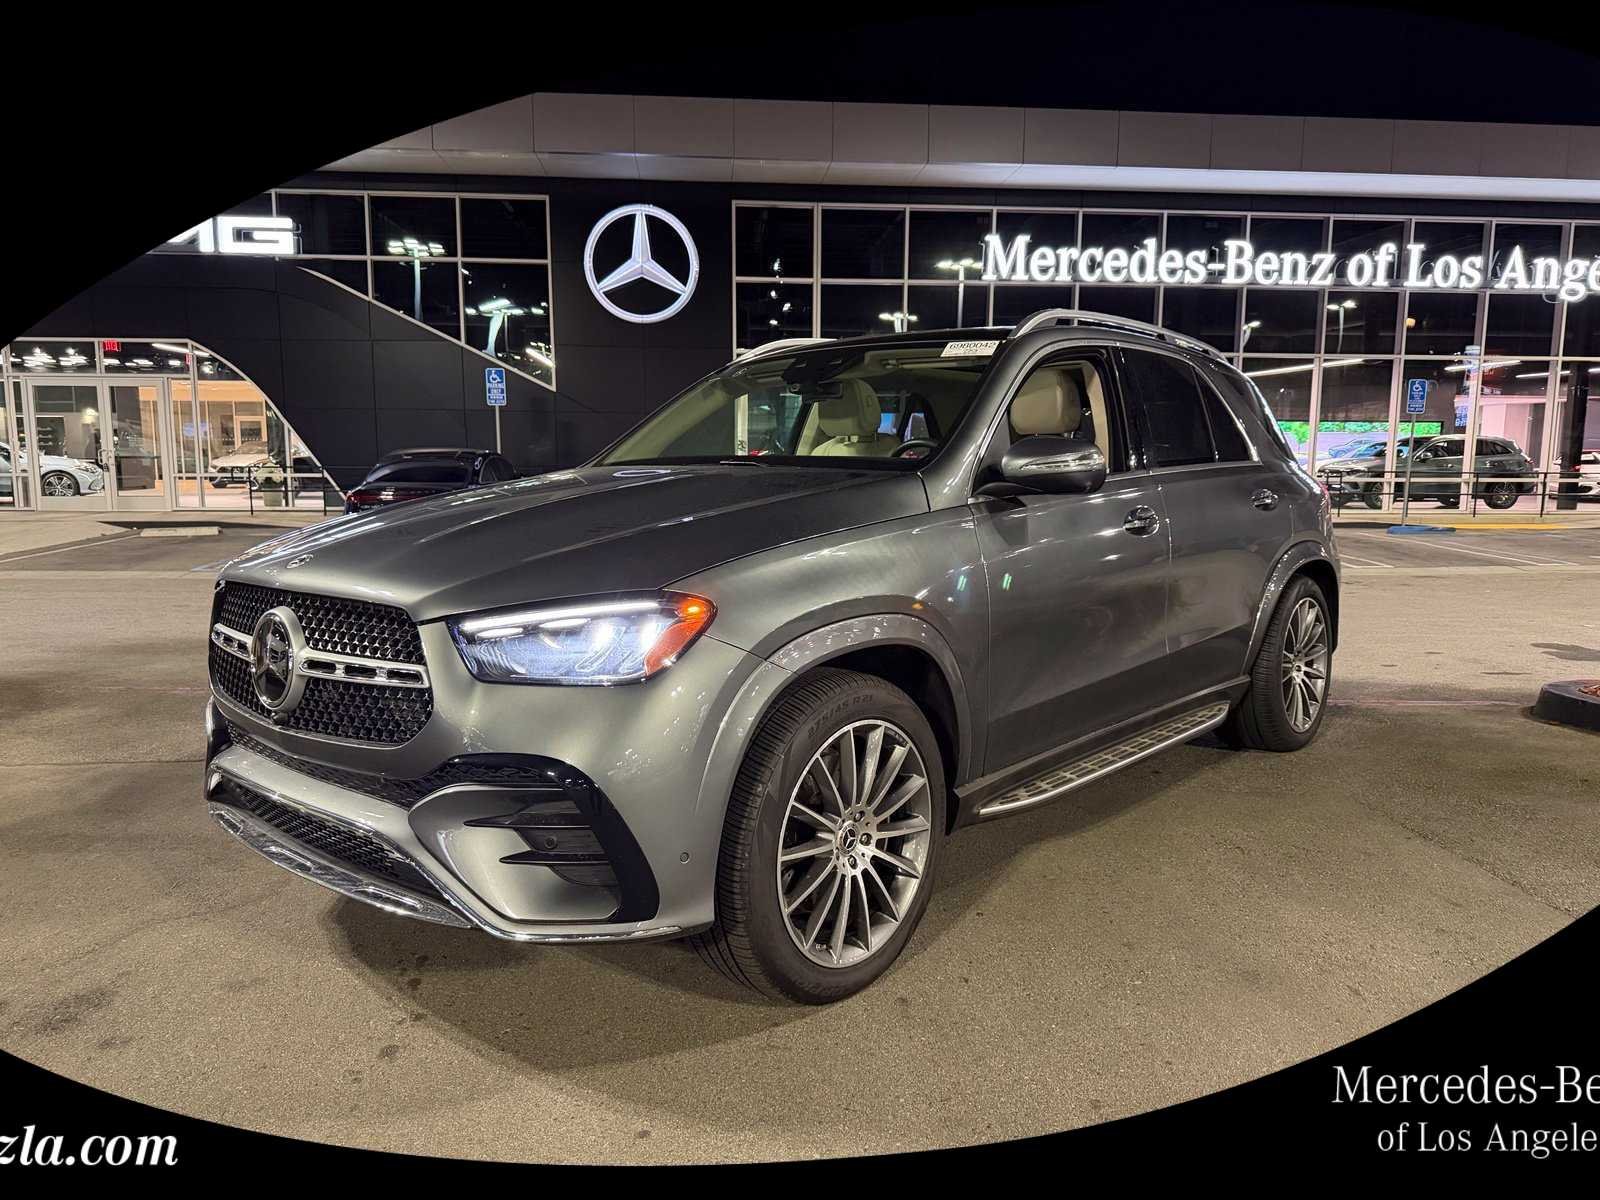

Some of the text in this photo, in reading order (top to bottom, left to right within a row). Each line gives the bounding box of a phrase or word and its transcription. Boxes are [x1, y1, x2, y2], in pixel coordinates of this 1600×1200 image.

[982, 234, 1336, 286] Mercedes-Benz
[1347, 243, 1397, 287] of
[1404, 244, 1483, 288] Los
